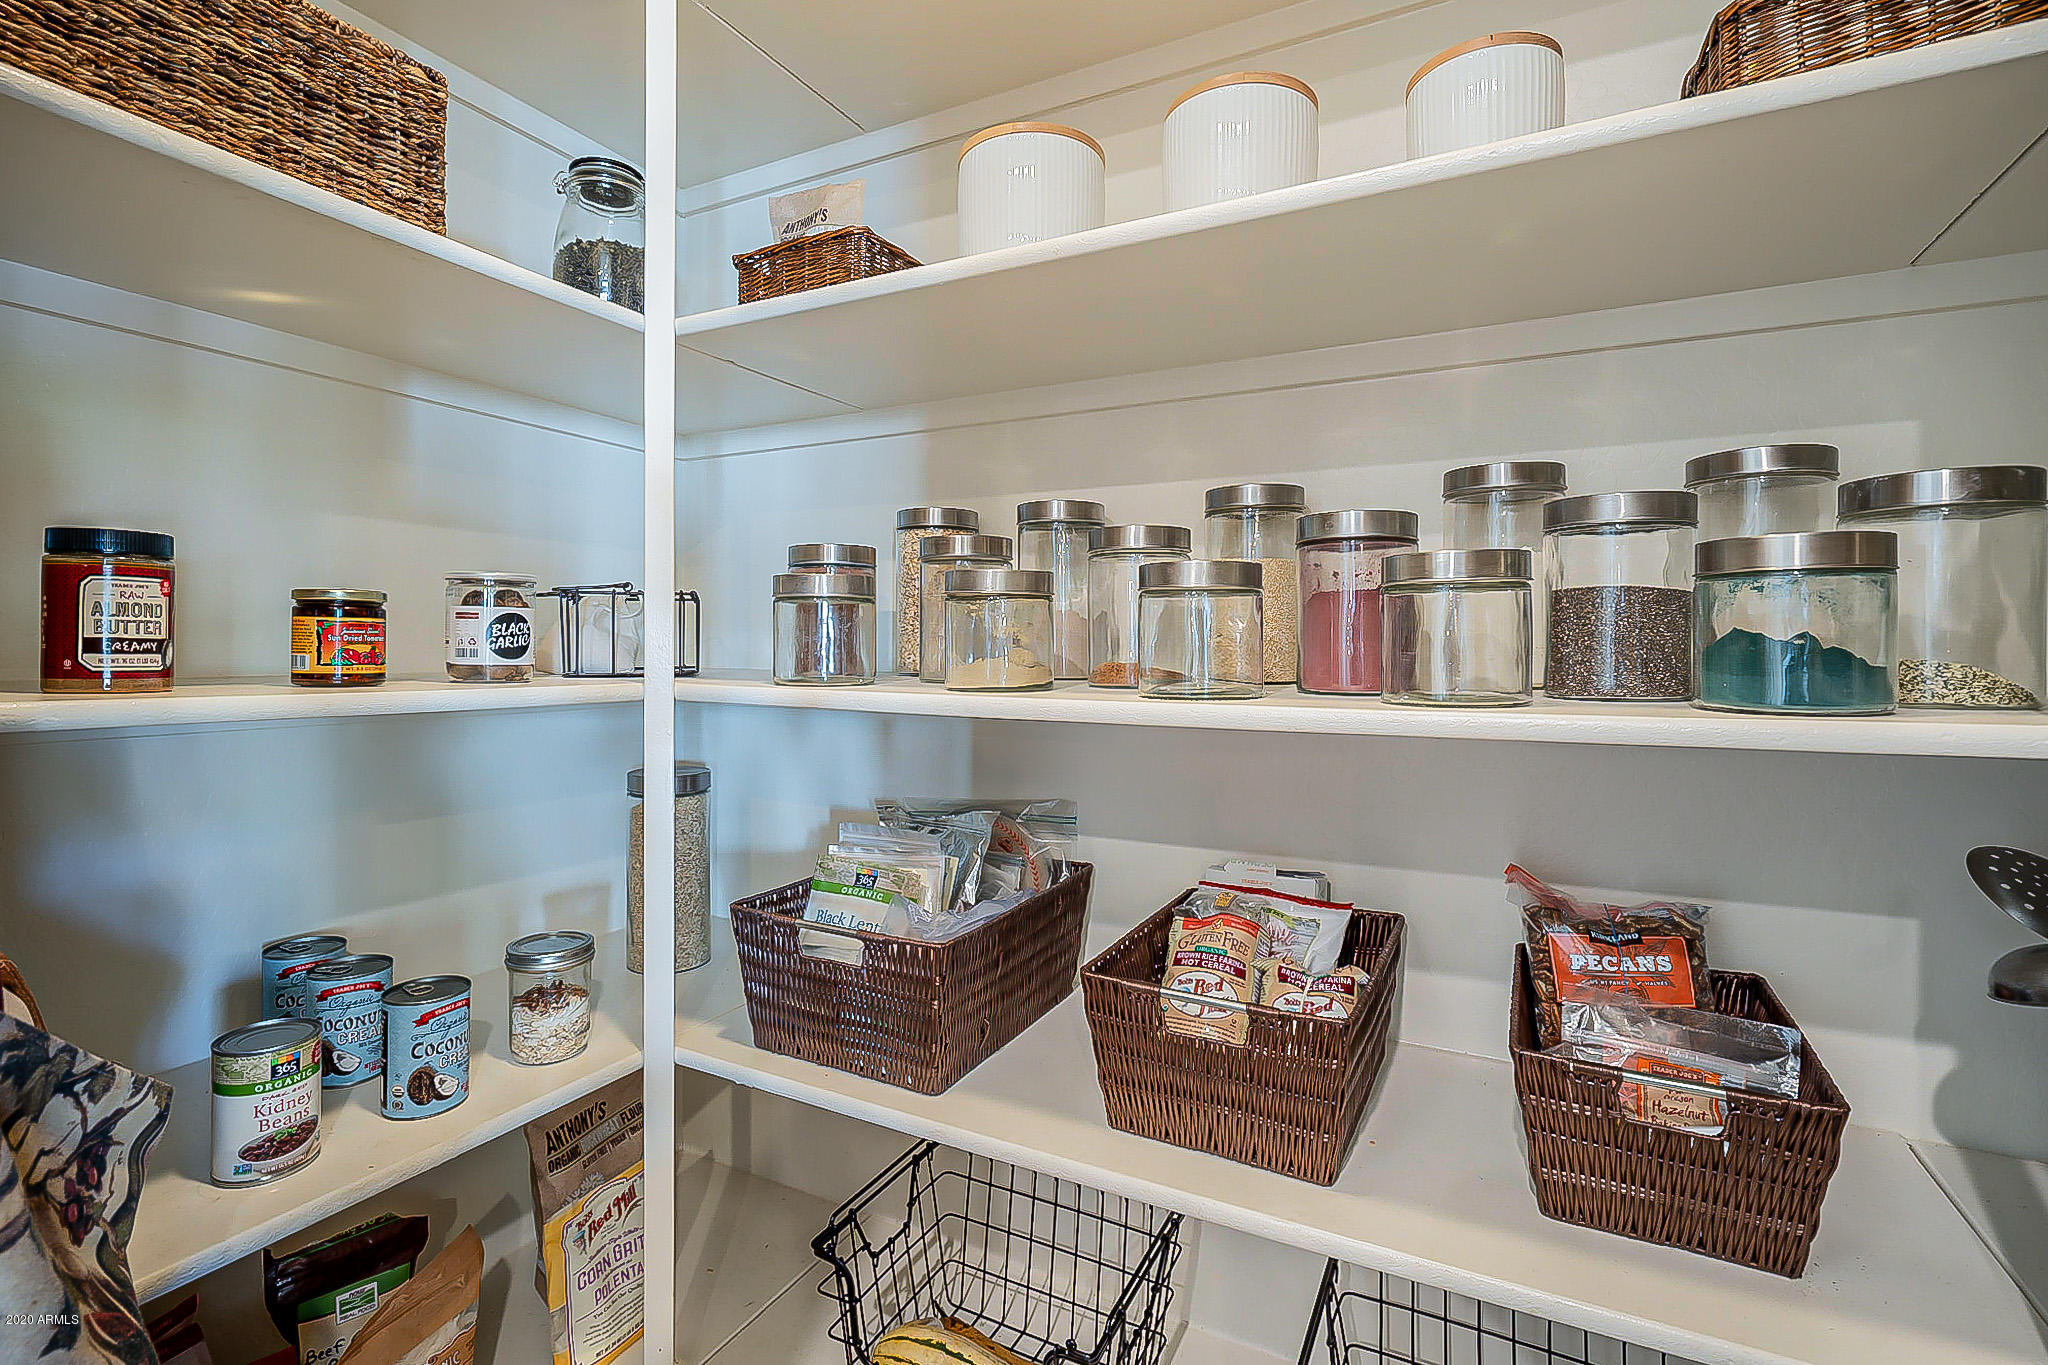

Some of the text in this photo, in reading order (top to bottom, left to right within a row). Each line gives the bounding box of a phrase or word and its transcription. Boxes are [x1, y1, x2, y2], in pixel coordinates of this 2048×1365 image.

[781, 207, 829, 236] ANTHONY'S
[119, 591, 145, 600] RAW
[91, 601, 163, 618] ALMOND
[93, 619, 162, 635] BUTTER
[491, 622, 530, 637] BLACK
[327, 634, 341, 642] Sun
[343, 634, 363, 642] Dried
[489, 634, 530, 650] GARLIC
[856, 874, 874, 888] 365
[841, 886, 884, 901] ORGANIC
[816, 909, 881, 933] Black Lent
[1177, 932, 1224, 950] GLUTEN
[1221, 930, 1251, 957] FREE
[1589, 930, 1639, 943] KIRKLAND
[1176, 951, 1202, 960] BROWN
[1201, 952, 1218, 962] RICE
[1569, 953, 1674, 973] PECANS
[1180, 958, 1237, 975] HOT CEREAL
[1280, 967, 1309, 983] BROWN
[332, 985, 355, 994] TRADER
[1193, 977, 1224, 995] Red
[1308, 982, 1345, 992] CEREAL
[328, 994, 375, 1018] Organic
[1302, 997, 1335, 1015] Red
[322, 1008, 382, 1033] OCONU
[411, 1029, 469, 1060] COCONU
[275, 1060, 298, 1077] 365
[1652, 1065, 1678, 1077] TRADER
[254, 1068, 314, 1094] ORGANIC
[253, 1089, 314, 1120] Kidney
[1663, 1094, 1695, 1104] Oregon
[258, 1106, 311, 1133] Beans
[619, 1101, 644, 1125] FLOUR
[1652, 1099, 1710, 1122] Hazelnut
[545, 1100, 608, 1157] ANTHONY'S
[587, 1202, 614, 1248] Red
[612, 1181, 638, 1223] Mill
[577, 1252, 612, 1292] CORN
[612, 1233, 644, 1263] GRIT
[594, 1261, 644, 1307] POLENTA
[304, 1337, 346, 1365] Beef
